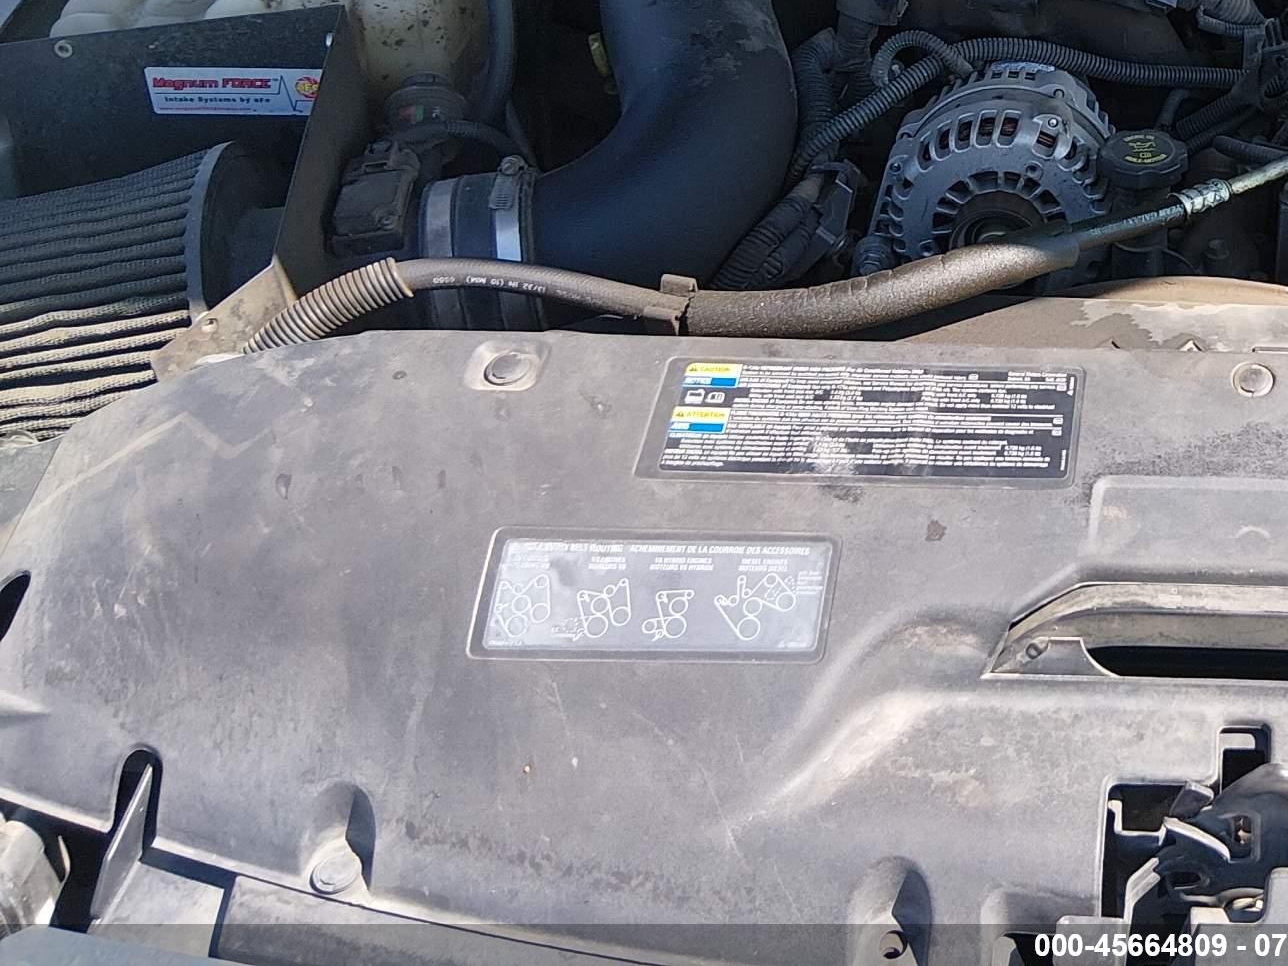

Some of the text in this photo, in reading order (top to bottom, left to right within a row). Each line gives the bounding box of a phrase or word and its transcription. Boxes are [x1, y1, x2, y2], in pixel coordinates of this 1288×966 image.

[152, 77, 272, 91] Magnum FORCE
[198, 96, 235, 105] Systems
[240, 97, 251, 105] by
[687, 545, 696, 554] DE
[697, 546, 708, 554] LA
[746, 547, 761, 555] DES
[762, 547, 810, 556] ACCESSOIRES
